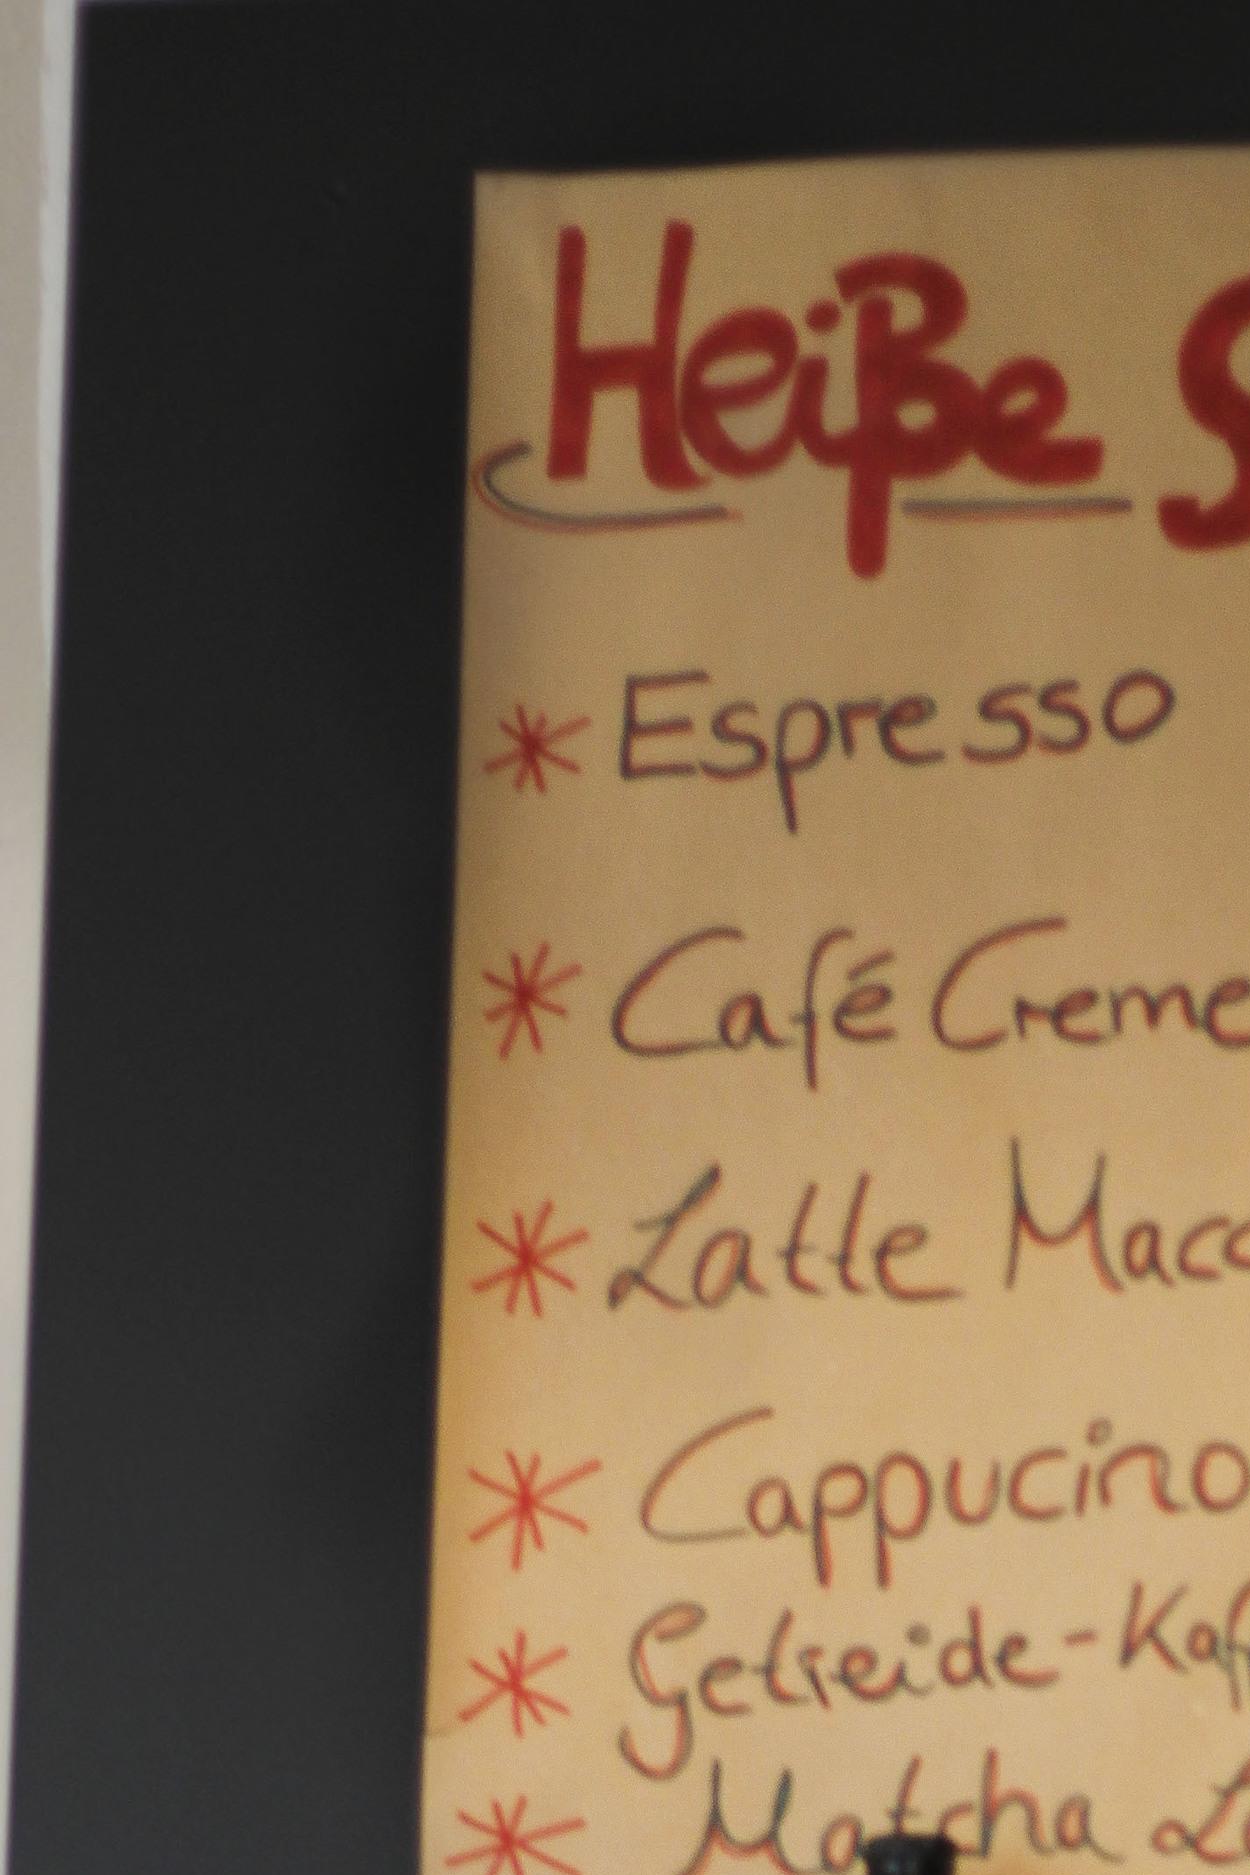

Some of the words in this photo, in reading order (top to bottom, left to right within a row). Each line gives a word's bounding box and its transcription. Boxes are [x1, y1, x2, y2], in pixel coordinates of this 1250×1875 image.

[547, 219, 1104, 580] Heiße
[619, 668, 1176, 834] Espresso
[611, 926, 896, 1091] Café
[609, 1163, 965, 1311] Latte
